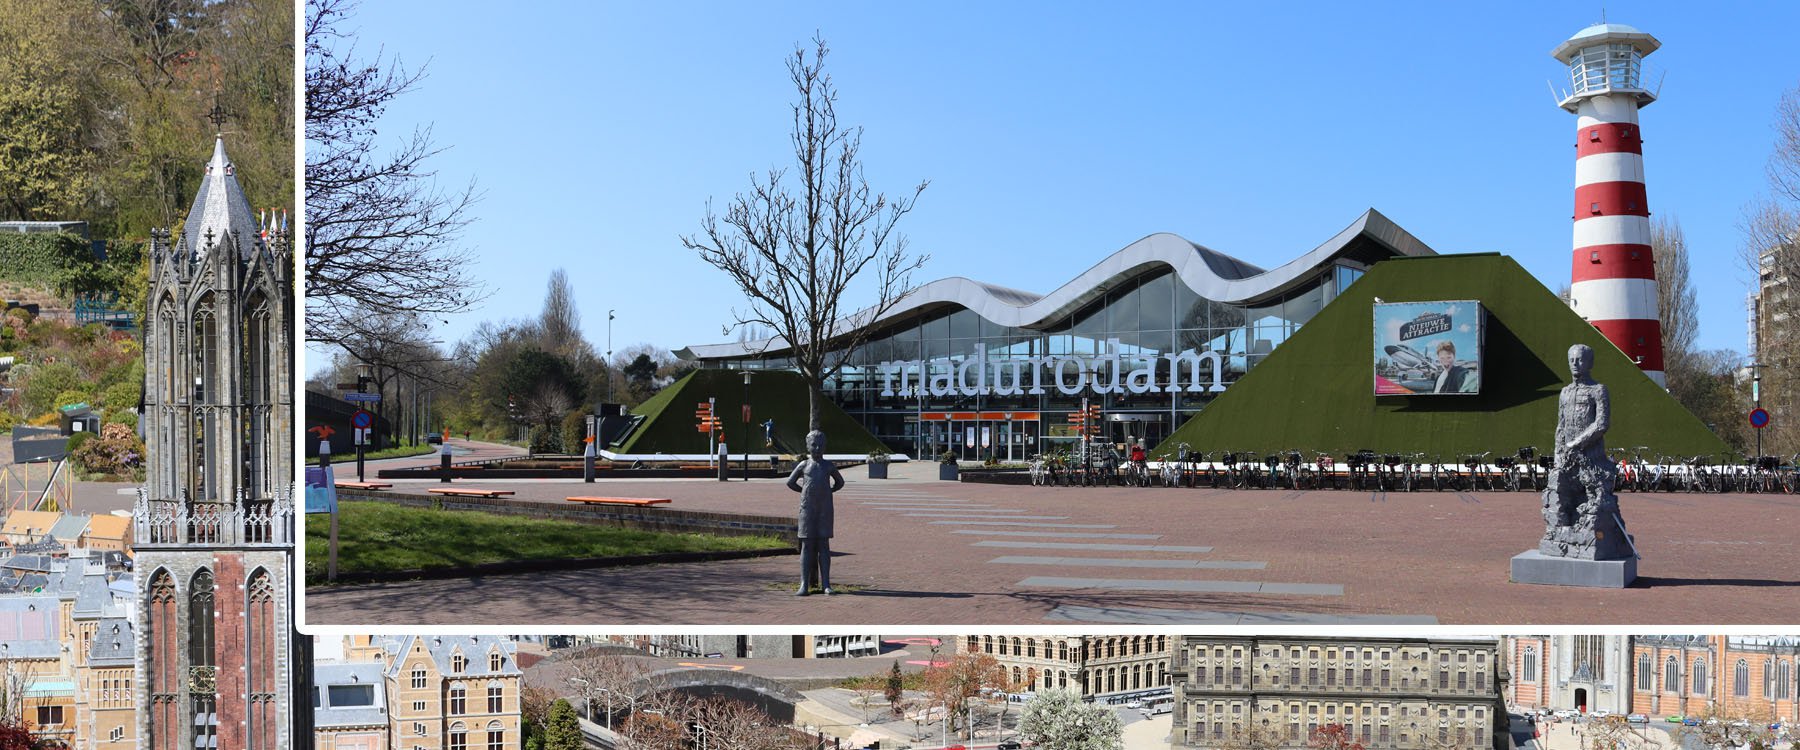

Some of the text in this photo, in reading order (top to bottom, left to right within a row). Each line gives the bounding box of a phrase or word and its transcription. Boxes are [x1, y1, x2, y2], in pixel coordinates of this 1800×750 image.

[1403, 323, 1449, 340] ATTRACTIE
[1409, 318, 1446, 332] NIEUWE
[880, 338, 1227, 397] madurodam
